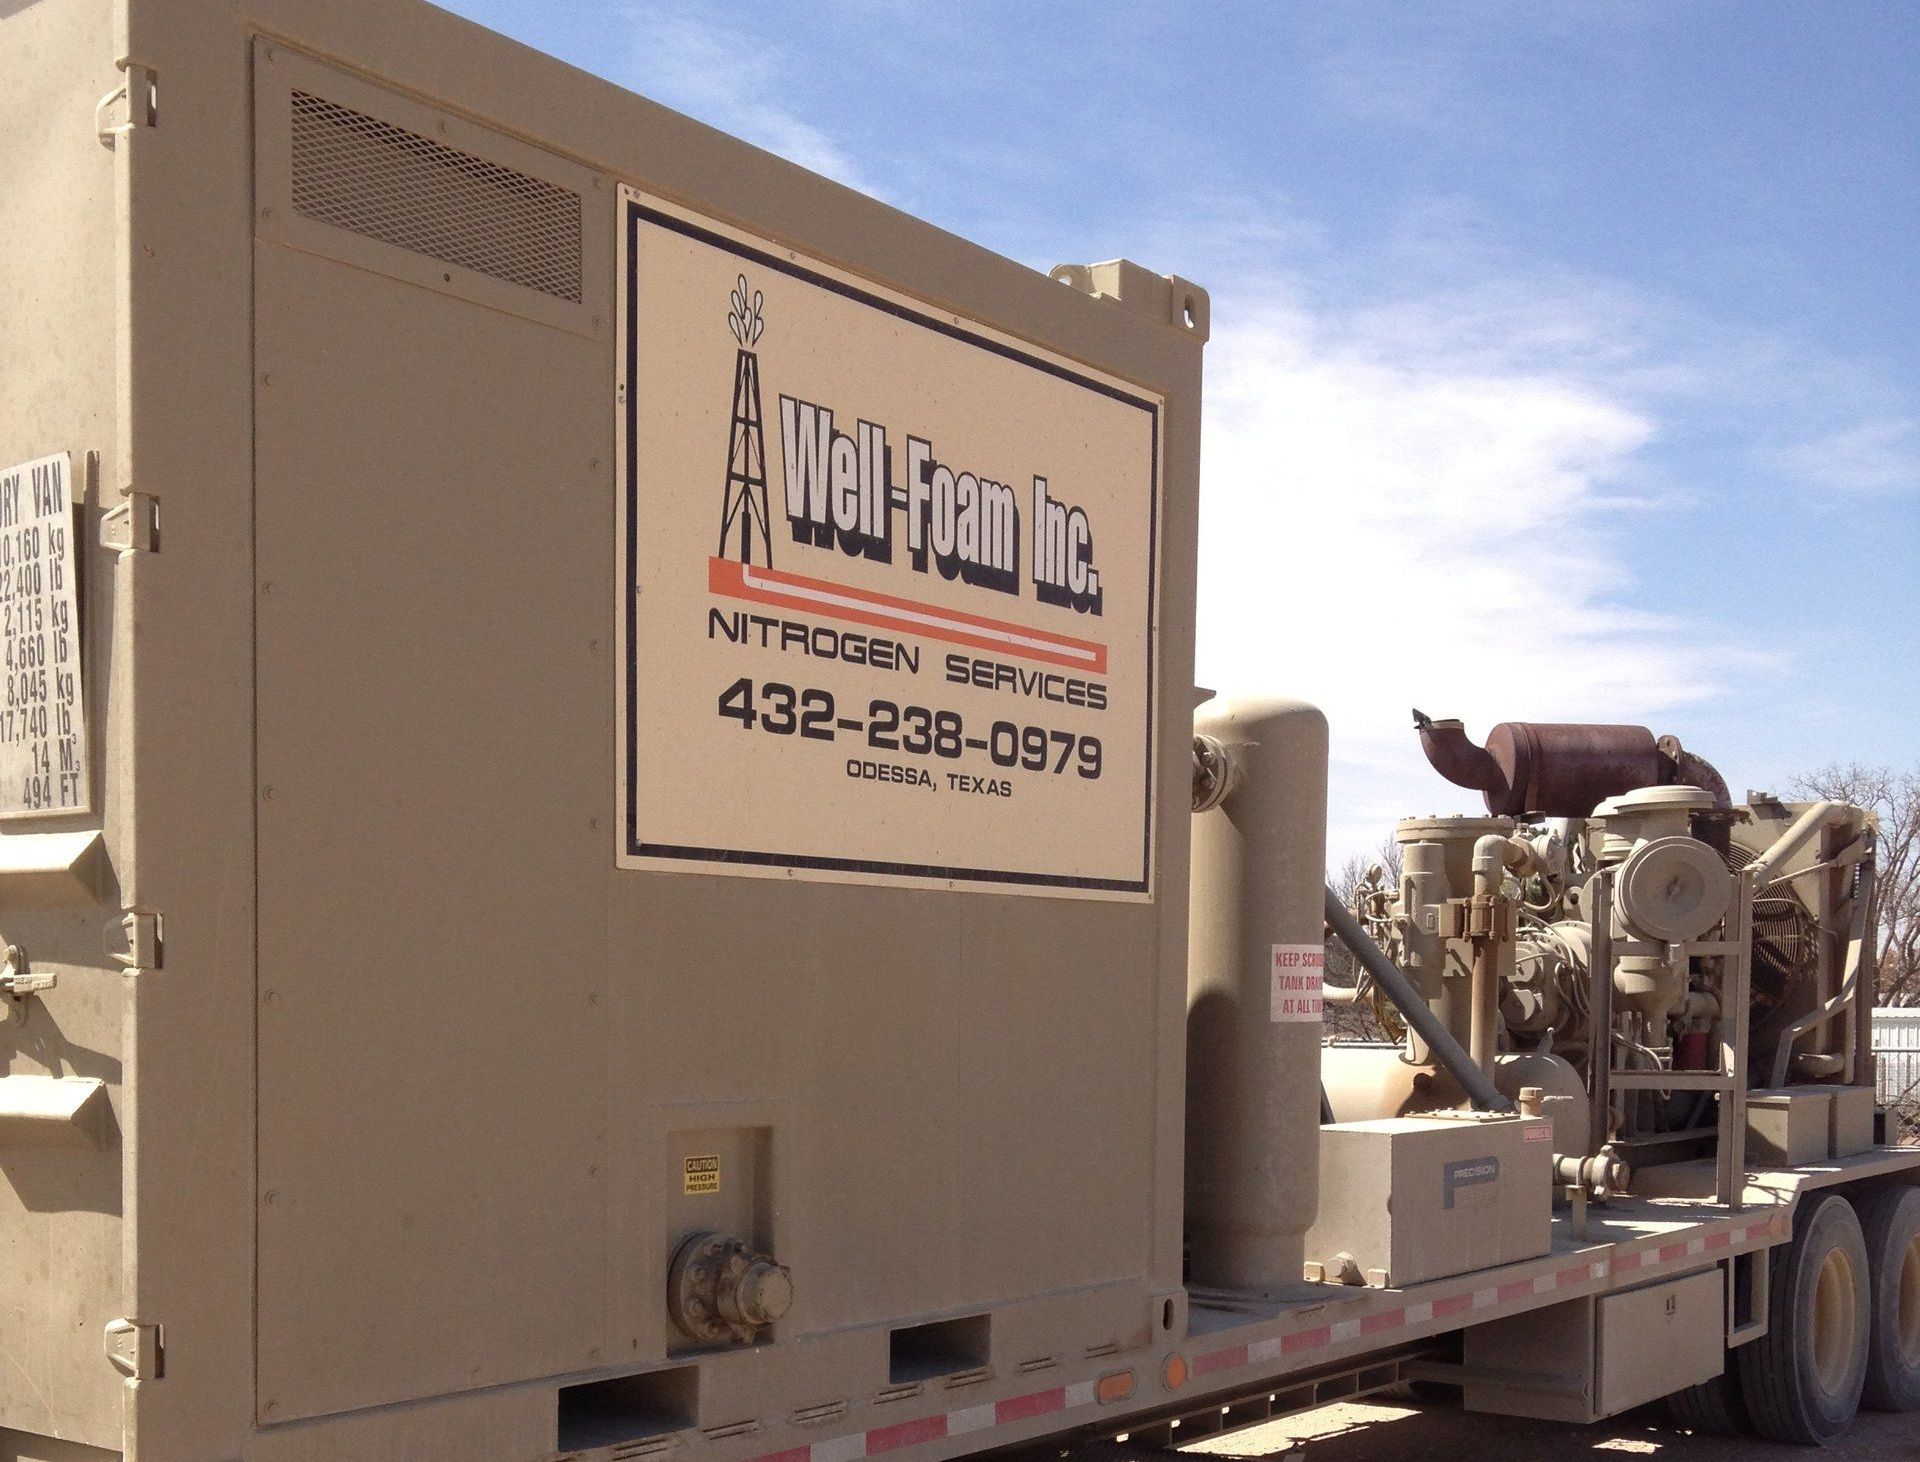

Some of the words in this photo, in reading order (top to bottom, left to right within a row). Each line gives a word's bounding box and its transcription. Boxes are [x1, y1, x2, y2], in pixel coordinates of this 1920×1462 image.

[0, 473, 20, 528] RY
[32, 460, 63, 518] VAN
[779, 393, 1020, 596] Well-Foam
[1033, 474, 1103, 616] Inc.
[0, 526, 40, 570] 0,160
[48, 522, 65, 561] kg
[50, 558, 63, 592] lb
[4, 598, 43, 639] 2,115
[51, 595, 69, 634] kg
[6, 633, 45, 677] 4,660
[53, 630, 67, 664] lb
[708, 607, 920, 674] NITROGEN
[946, 654, 1108, 710] SERVICES
[7, 669, 47, 710] 8,045
[56, 667, 74, 706] kg
[56, 702, 71, 736] lb
[718, 677, 1103, 780] 432-238-0979
[31, 741, 50, 775] 14
[23, 775, 51, 809] 494
[846, 759, 937, 792] ODESSA,
[947, 773, 1012, 798] TEXAS
[1276, 953, 1300, 967] KEEP
[1279, 976, 1304, 990] TANK
[1283, 1000, 1295, 1013] AT
[1297, 1000, 1310, 1013] ALL
[688, 1159, 718, 1171] CAUTION
[689, 1174, 715, 1182] HIGH
[1454, 1165, 1496, 1178] PRECISION
[686, 1183, 717, 1192] PRESSURE
